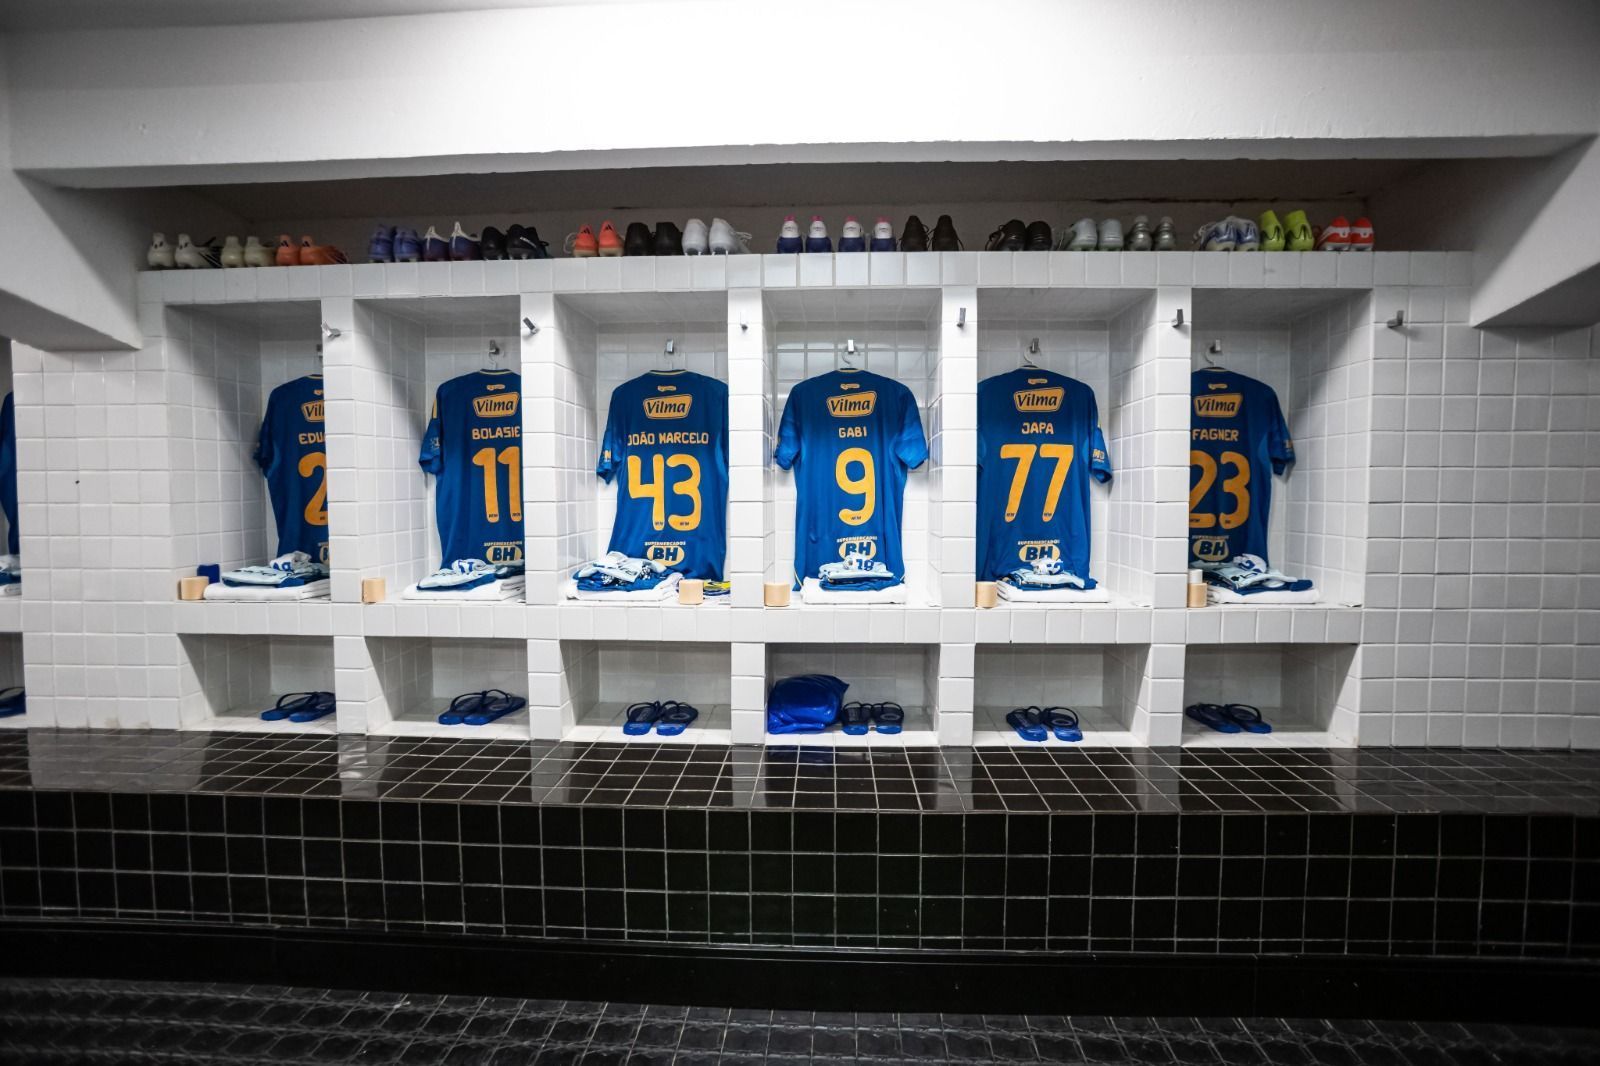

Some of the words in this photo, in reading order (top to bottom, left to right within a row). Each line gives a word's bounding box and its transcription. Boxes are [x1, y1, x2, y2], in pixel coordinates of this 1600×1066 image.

[476, 400, 514, 413] Vilma
[647, 401, 686, 414] Vilma
[830, 398, 871, 413] Vilma
[1017, 393, 1058, 407] Vilma
[1197, 398, 1236, 412] Vilma
[305, 404, 324, 418] Vil
[472, 426, 520, 440] BOLASIE
[838, 426, 867, 439] GABI
[1021, 422, 1054, 435] JAPA
[1192, 428, 1239, 441] FAGNER
[298, 431, 325, 445] EDU
[627, 431, 655, 446] JOÃO
[658, 432, 709, 445] MARCELO
[472, 446, 522, 523] 11
[835, 447, 876, 526] 9
[1000, 443, 1074, 522] 77
[1189, 449, 1251, 529] 23
[627, 453, 702, 531] 43
[492, 547, 516, 562] BH
[652, 547, 678, 562] BH
[1025, 546, 1054, 561] BH
[1199, 540, 1226, 556] BH
